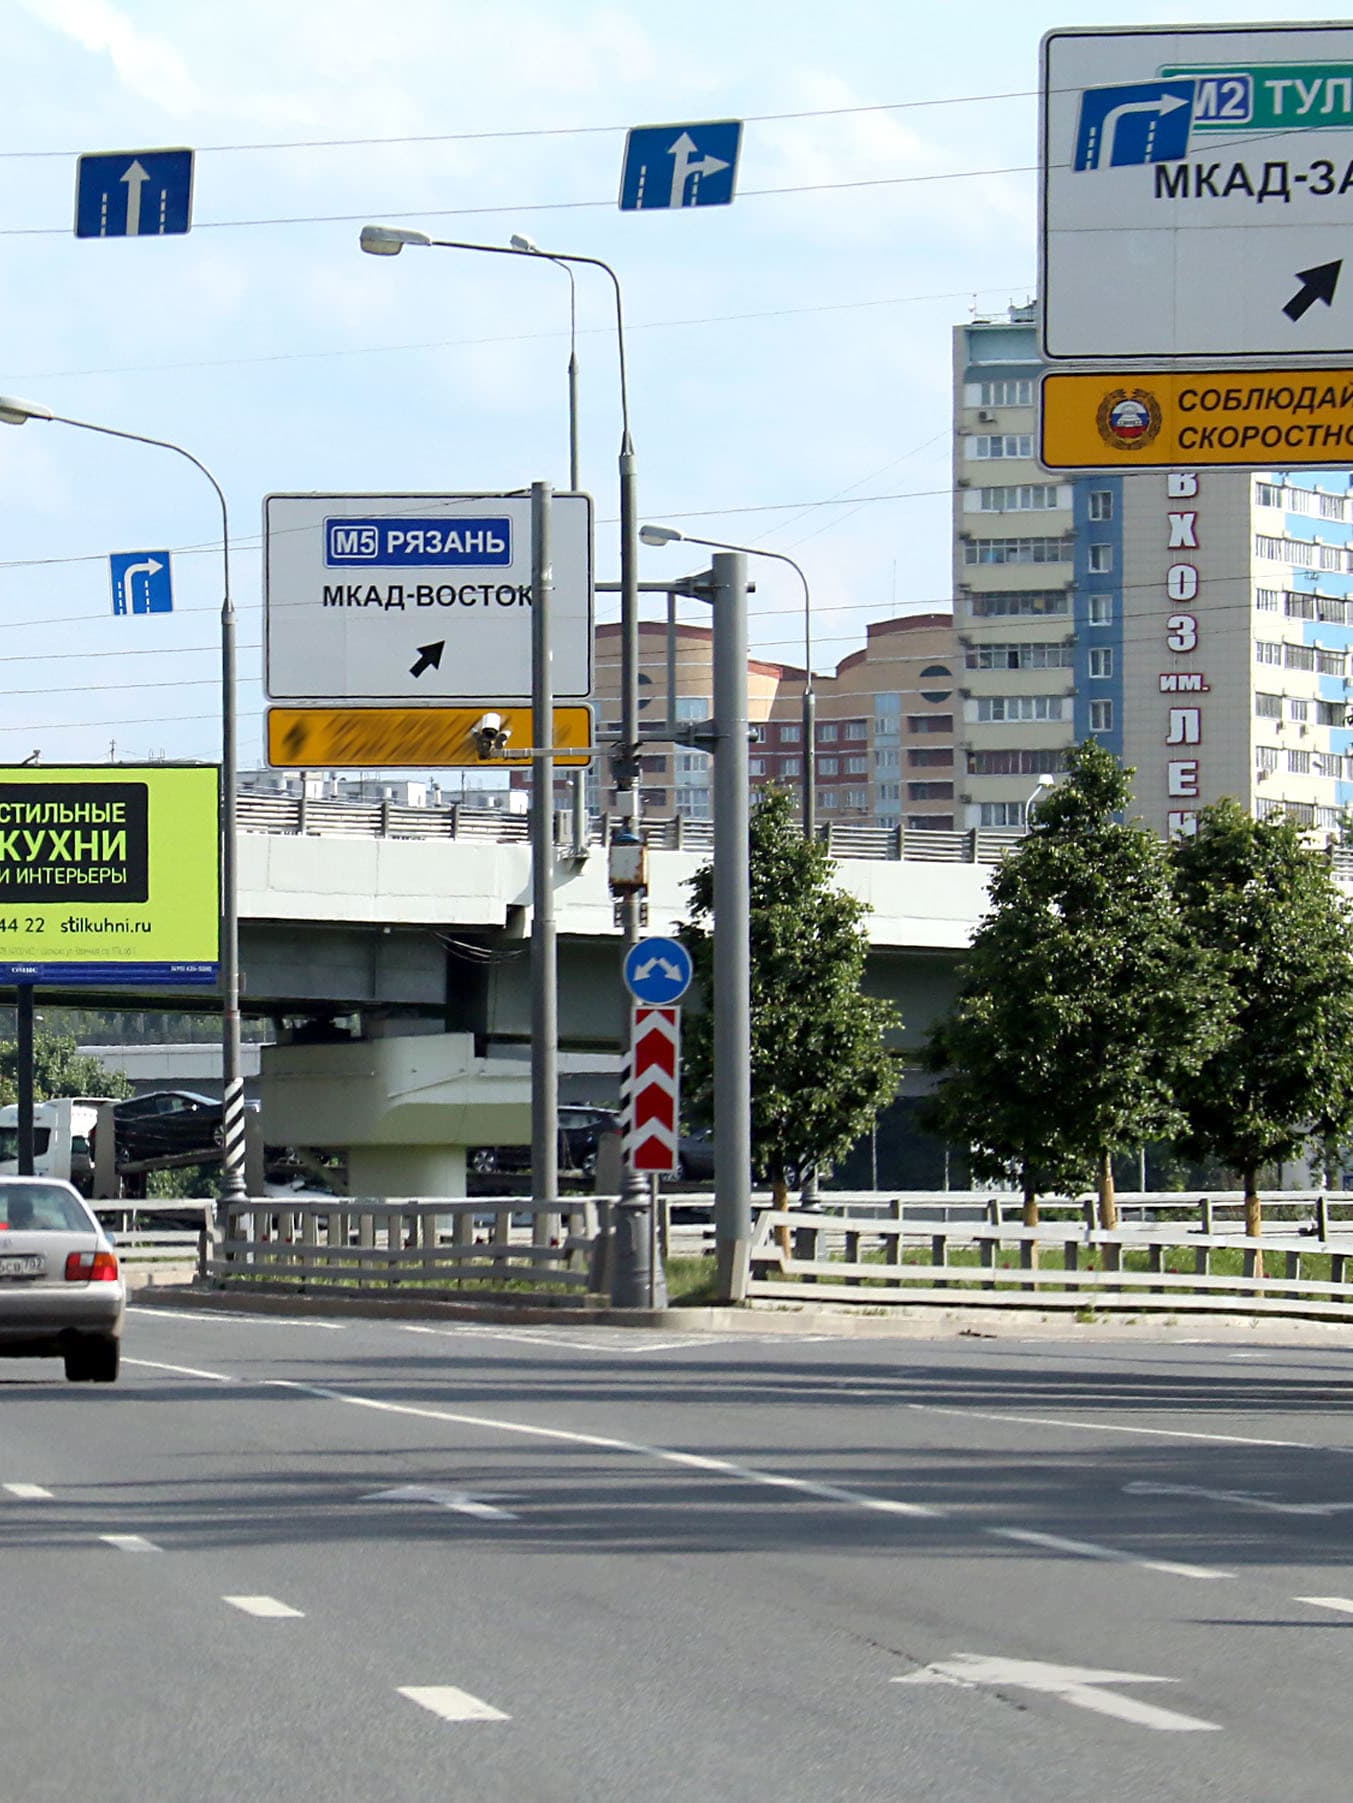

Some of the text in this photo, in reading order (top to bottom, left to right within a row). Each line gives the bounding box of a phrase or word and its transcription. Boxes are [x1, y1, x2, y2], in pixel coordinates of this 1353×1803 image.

[336, 530, 505, 554] М5 РЯЗАНЬ
[323, 584, 532, 611] МКАД-ВОСТОК
[17, 867, 127, 885] ИНТЕРЬЕРЫ
[25, 917, 45, 933] 22
[60, 915, 152, 934] stilkuhni.ru
